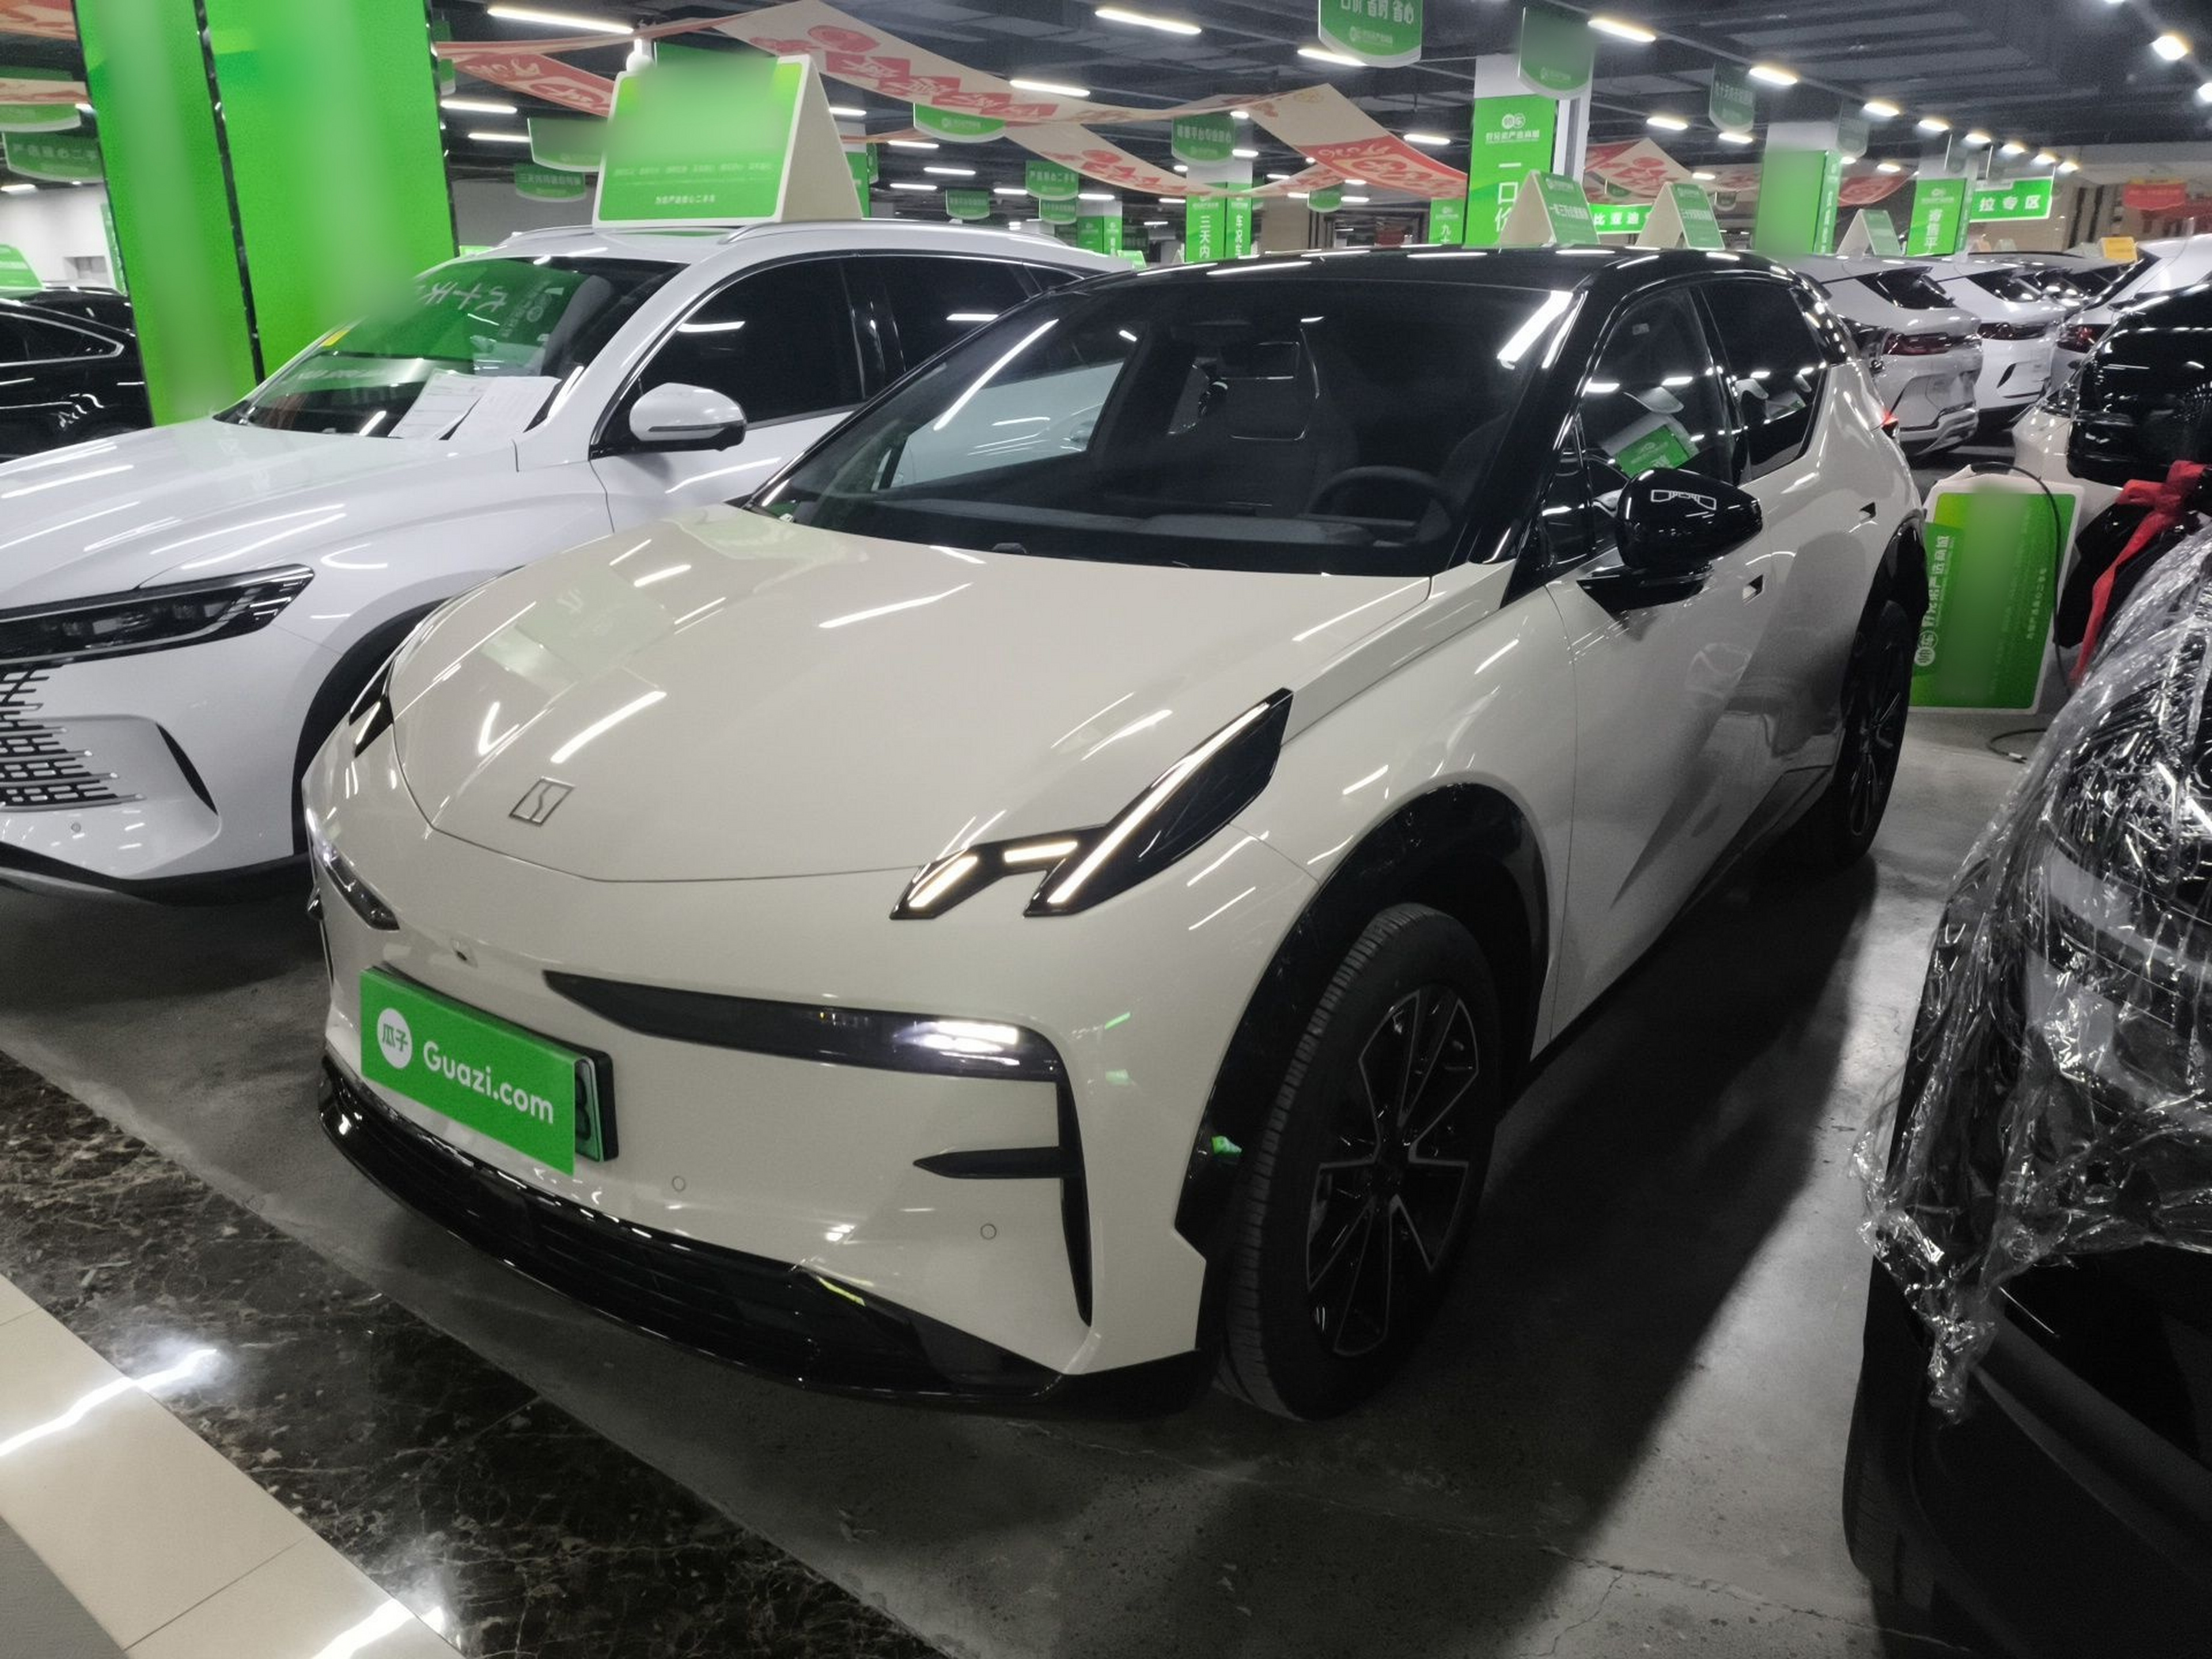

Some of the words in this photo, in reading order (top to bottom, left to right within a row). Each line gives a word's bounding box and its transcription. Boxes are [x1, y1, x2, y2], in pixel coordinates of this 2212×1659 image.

[1594, 212, 1651, 226] 比亚迪
[382, 1023, 408, 1052] 瓜子
[423, 1041, 554, 1124] Guazi.com
